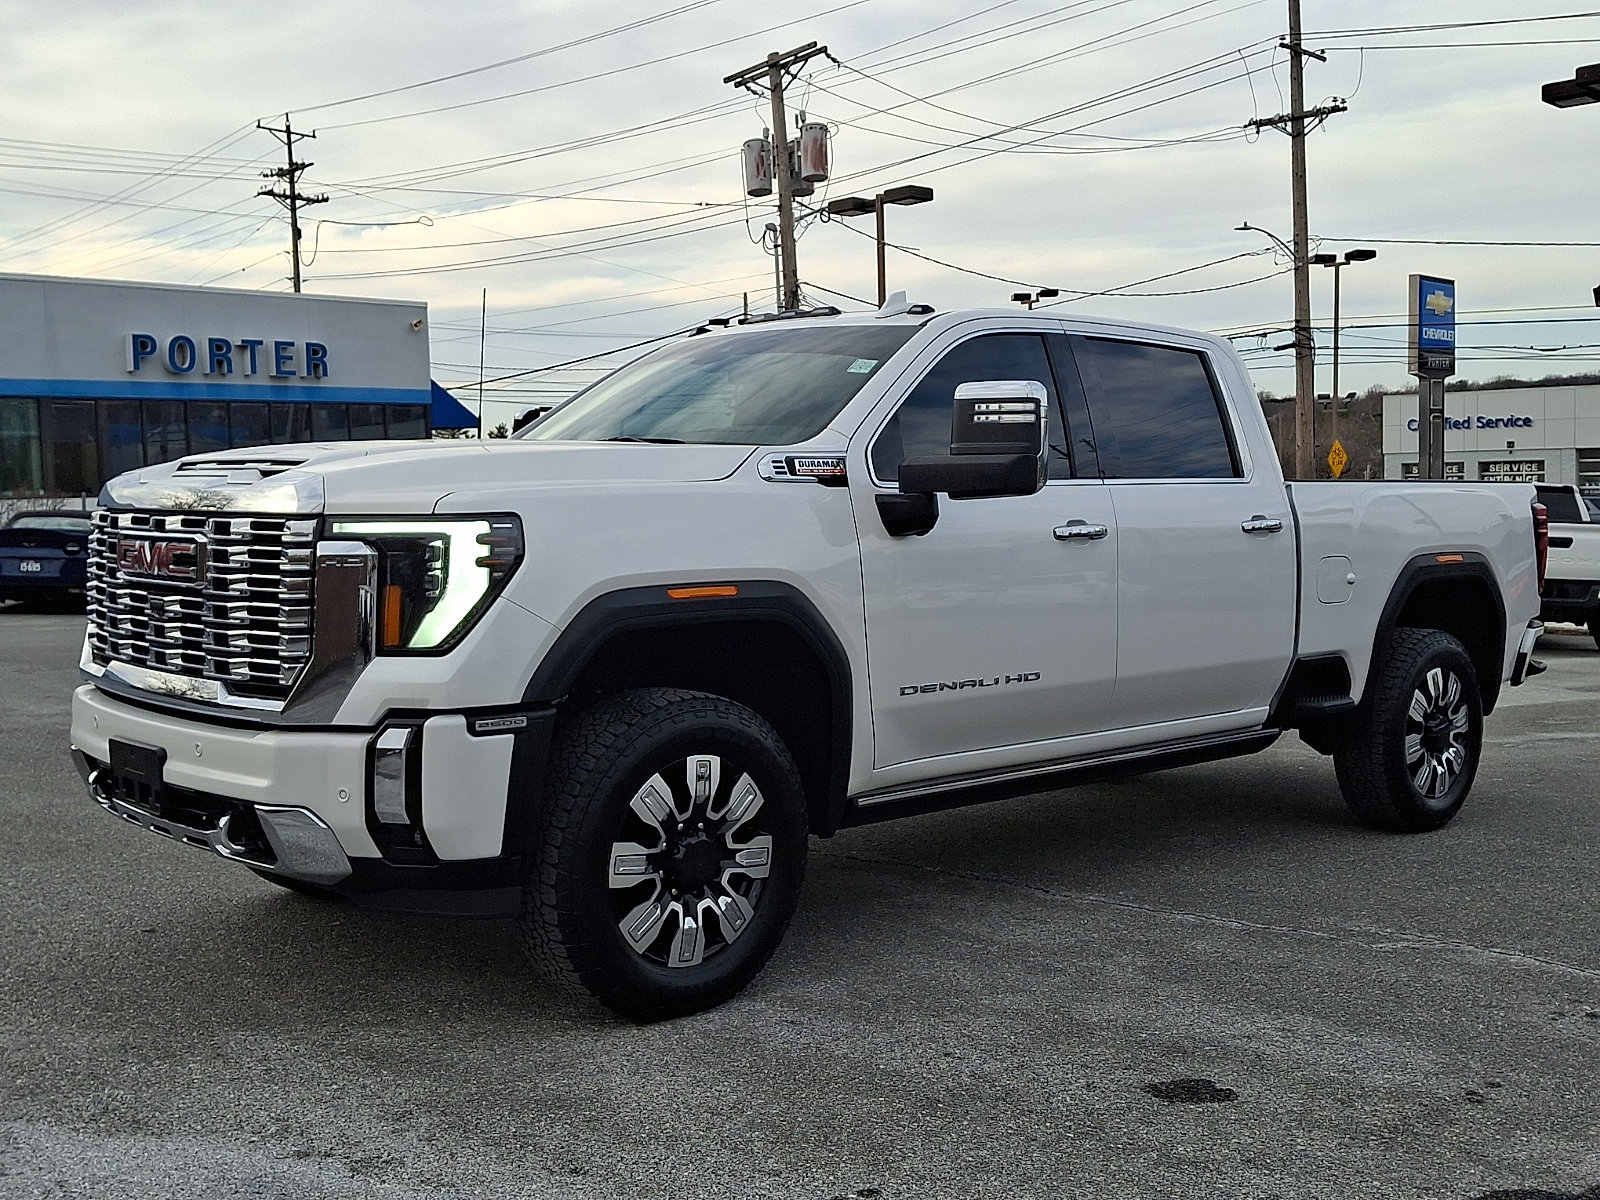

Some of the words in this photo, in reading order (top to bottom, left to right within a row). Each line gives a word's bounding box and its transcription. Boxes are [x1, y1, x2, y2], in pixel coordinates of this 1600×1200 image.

[1422, 327, 1455, 342] CHEVROLET
[126, 332, 329, 379] PORTER
[1407, 415, 1471, 432] Cfied
[1476, 414, 1533, 430] Service
[797, 460, 842, 468] DURAMAX
[1489, 462, 1539, 472] SERVICE
[117, 540, 197, 579] GMC
[899, 677, 1000, 697] DENALI
[1005, 671, 1041, 685] HD
[477, 718, 525, 730] 2500
